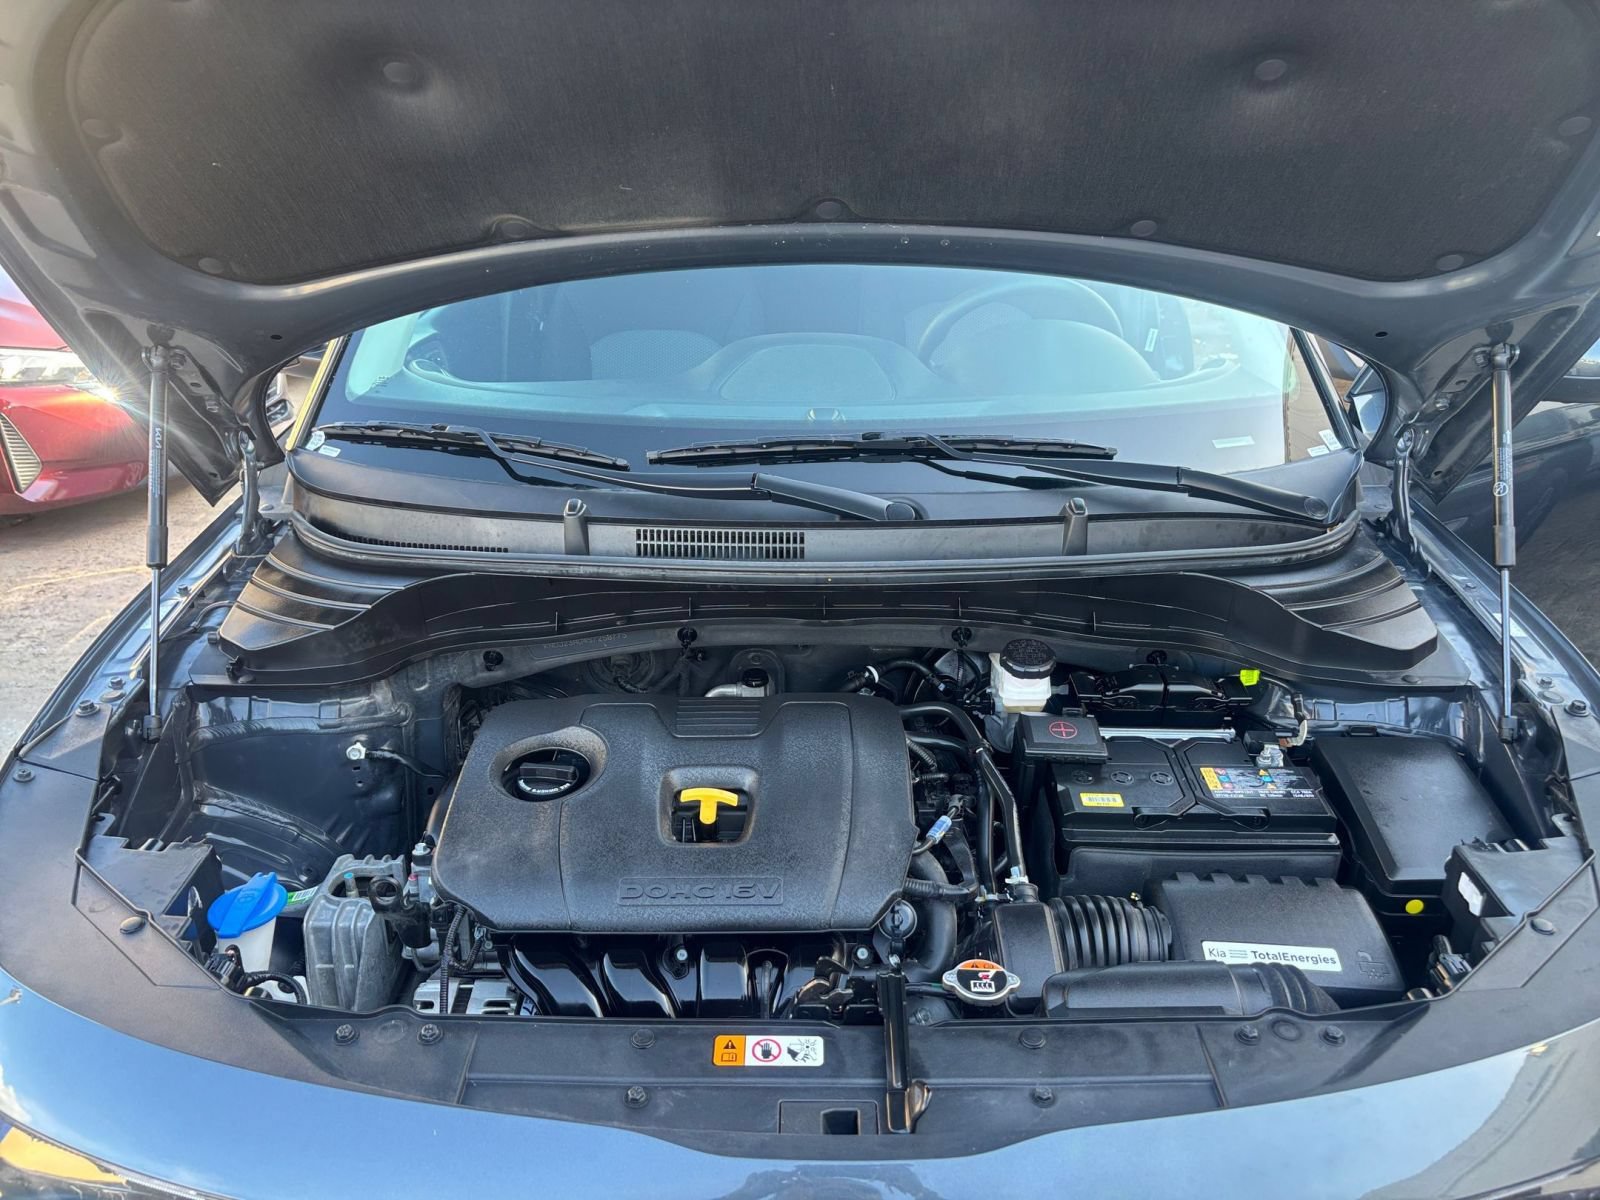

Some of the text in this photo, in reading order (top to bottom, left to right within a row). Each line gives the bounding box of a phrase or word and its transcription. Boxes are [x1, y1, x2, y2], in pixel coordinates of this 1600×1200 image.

[620, 882, 781, 900] DOHC 16V
[1208, 948, 1337, 965] Kia TotalEnergies
